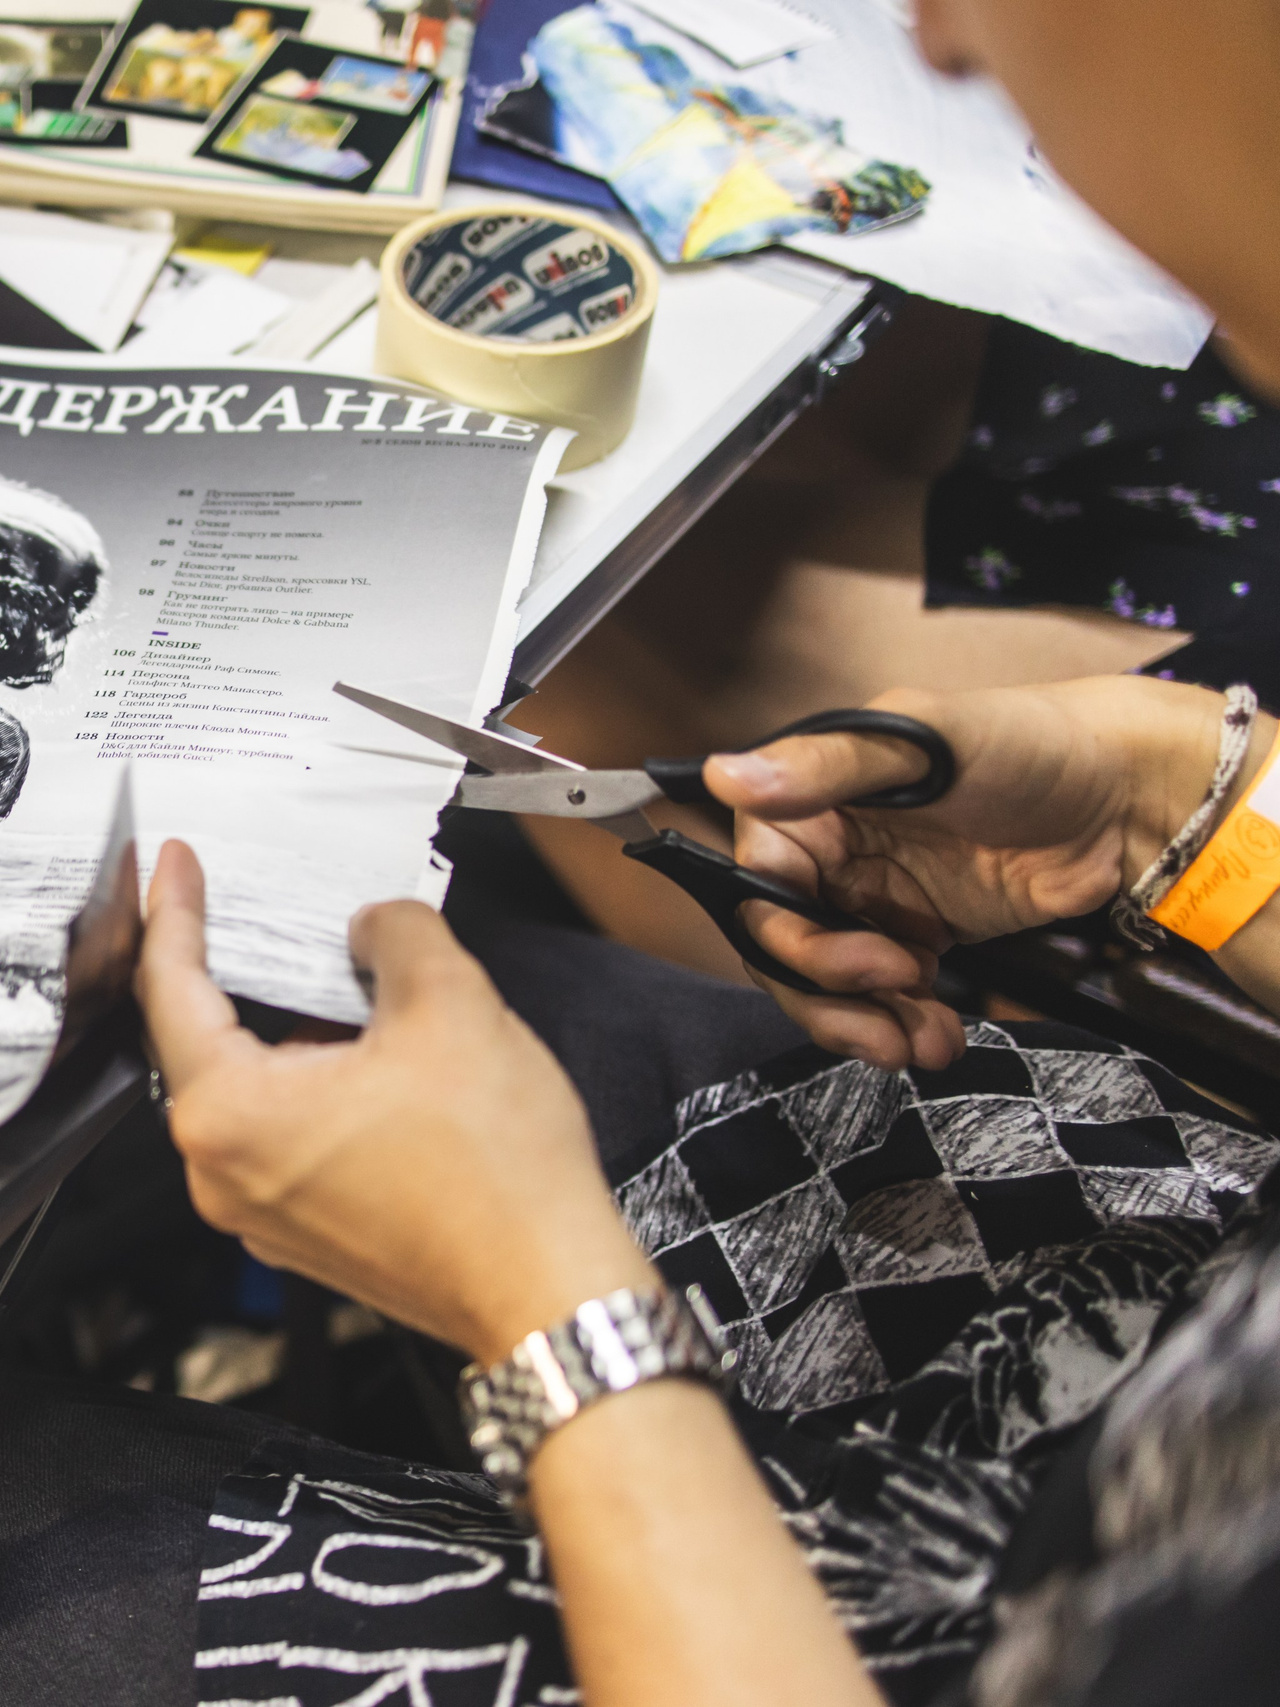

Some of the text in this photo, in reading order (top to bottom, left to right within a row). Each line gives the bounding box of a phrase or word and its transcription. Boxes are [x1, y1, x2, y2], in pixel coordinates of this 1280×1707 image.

[195, 519, 231, 528] Очки
[231, 530, 268, 540] спорту
[188, 540, 224, 550] Часы
[150, 559, 237, 573] 97 Новости
[171, 580, 197, 588] часы
[225, 583, 273, 593] рубашка
[291, 577, 348, 586] кроссовки
[138, 588, 229, 603] 98 Груминг
[163, 599, 183, 609] Как
[200, 603, 250, 615] потерять
[251, 607, 280, 617] лицо
[306, 611, 355, 621] примере
[156, 617, 193, 628] Milano
[159, 608, 208, 621] боксеров
[210, 613, 260, 625] команды
[262, 615, 292, 626] Dolce
[303, 618, 350, 629] Gabbana
[148, 638, 202, 650] INSIDE
[112, 648, 212, 663] 106 Дизайнер
[138, 658, 212, 672] Легендарный
[214, 664, 235, 674] Раф
[103, 669, 191, 681] 114 Персона
[128, 678, 179, 689] Гольфист
[181, 681, 221, 691] Маттео
[94, 689, 188, 701] 118 Гардероб
[118, 699, 155, 709] Сцены
[172, 702, 209, 711] жизни
[212, 703, 286, 718] Константина
[83, 711, 174, 721] 122 Легенда
[109, 720, 163, 730] Широкие
[165, 721, 199, 731] плечи
[201, 723, 235, 734] Клода
[74, 731, 165, 742] 128 Новости
[100, 741, 125, 750] D&G
[126, 743, 147, 751] для
[149, 742, 186, 752] Кайли
[136, 751, 181, 761] юбилей
